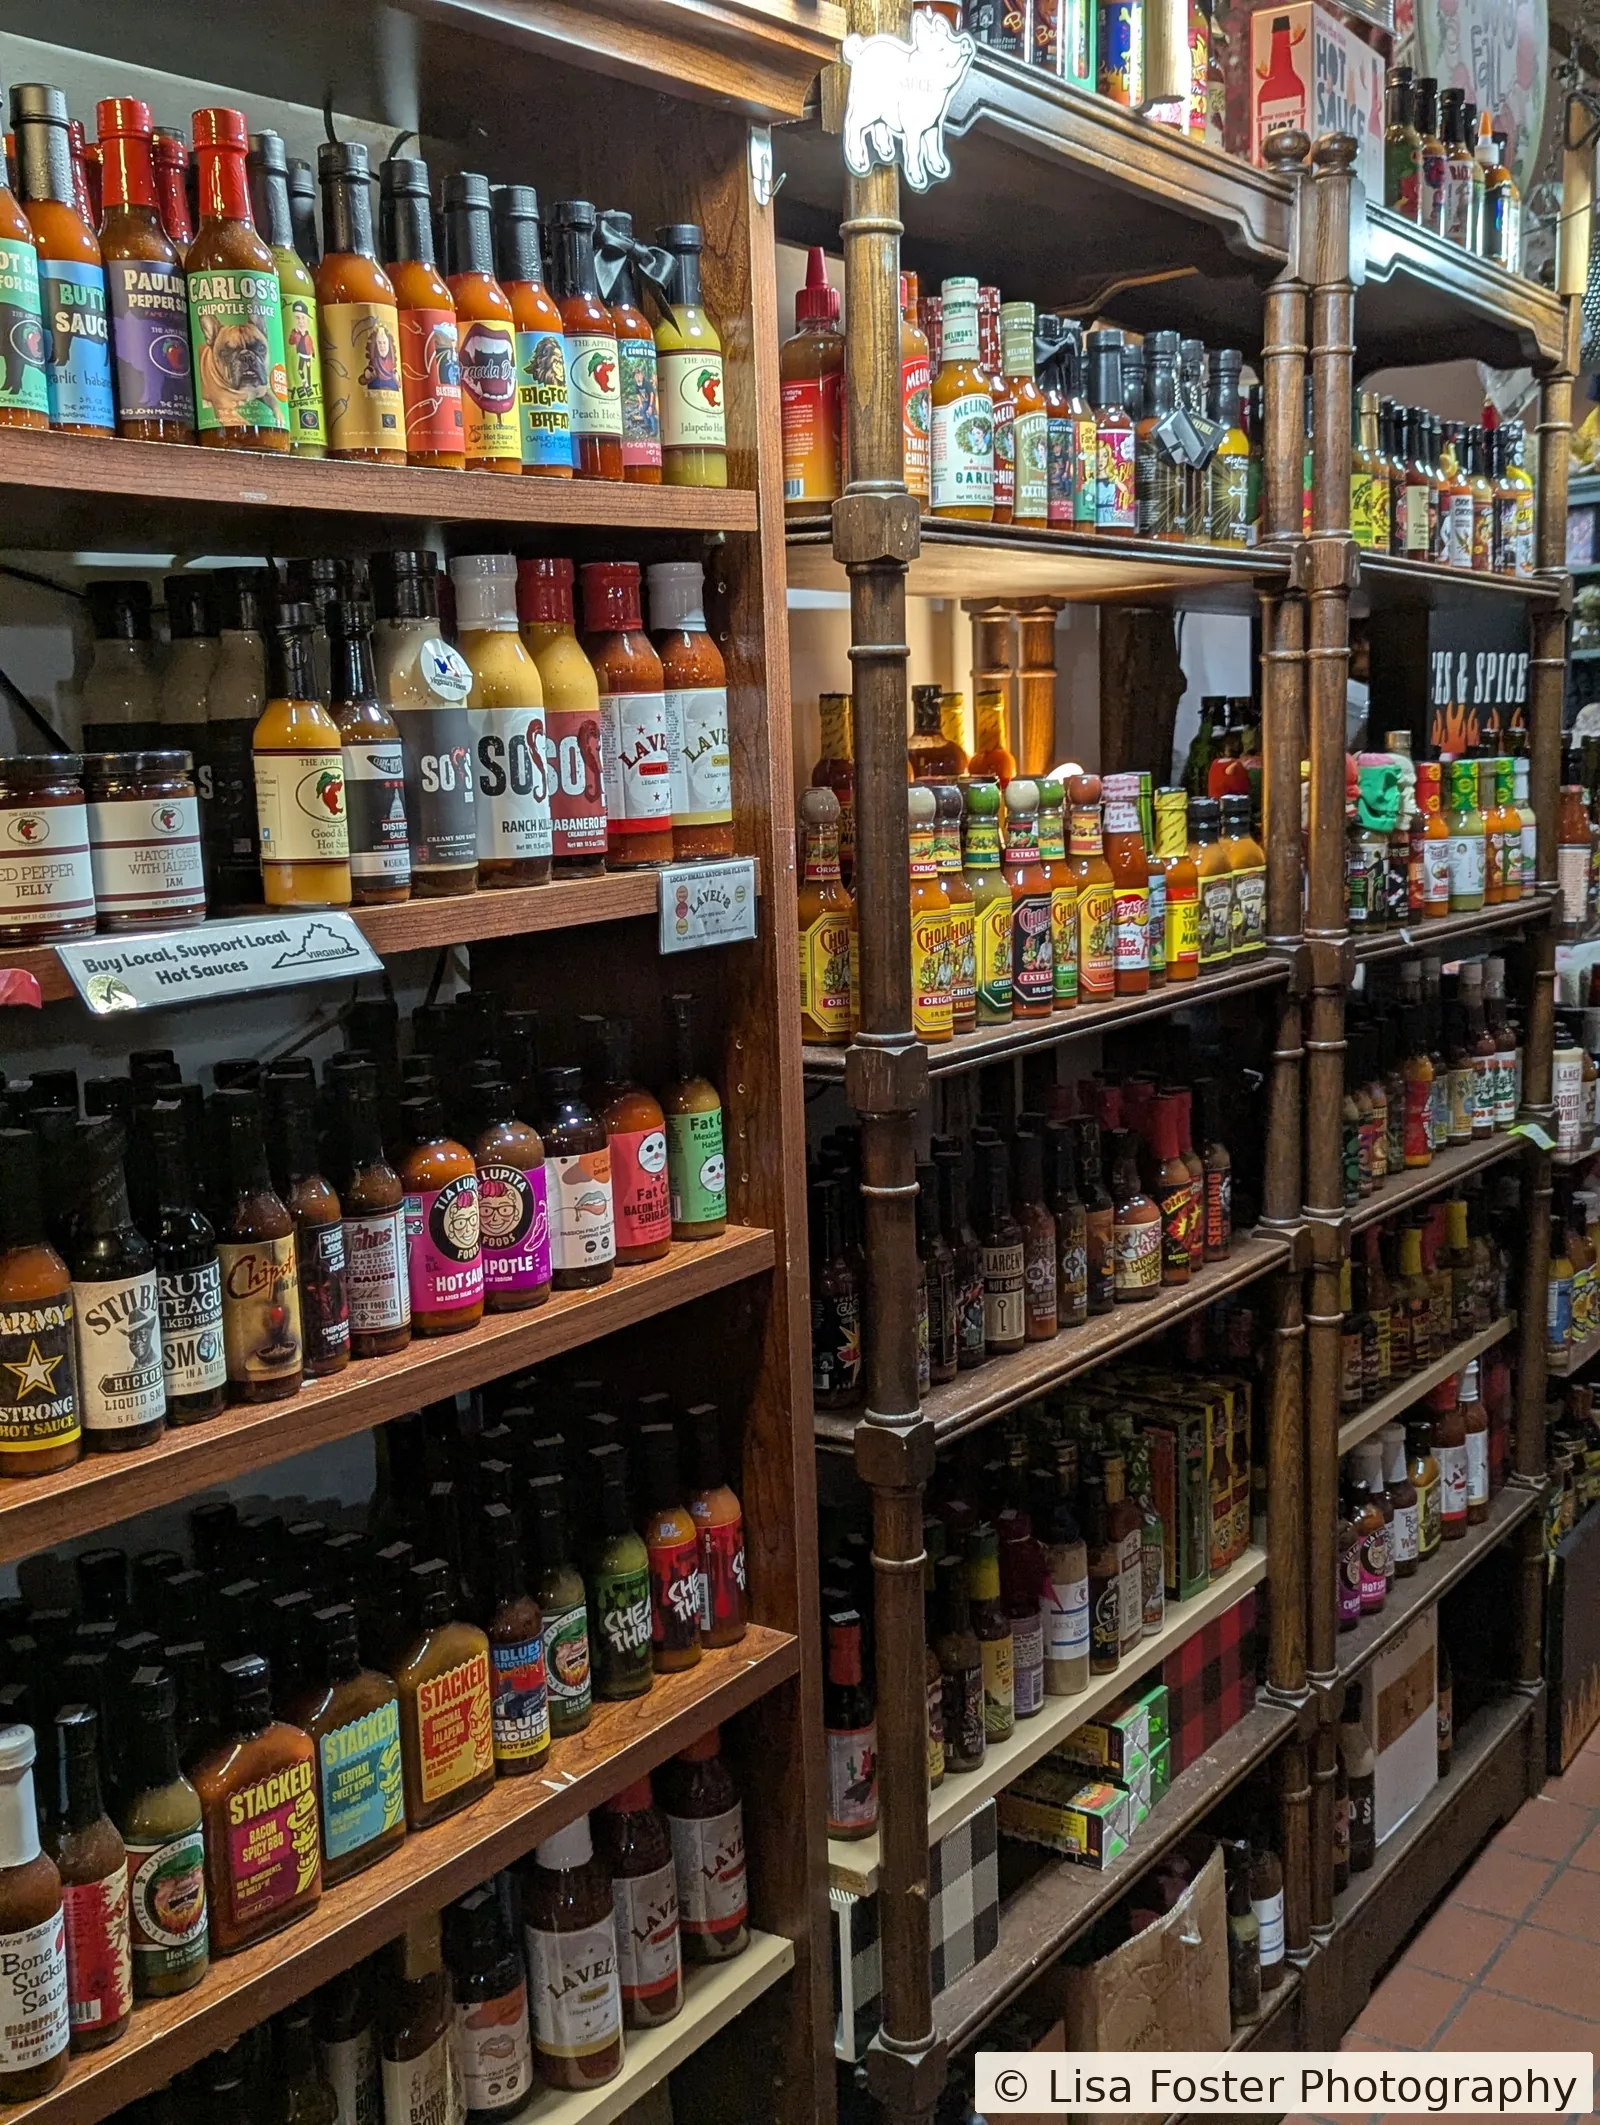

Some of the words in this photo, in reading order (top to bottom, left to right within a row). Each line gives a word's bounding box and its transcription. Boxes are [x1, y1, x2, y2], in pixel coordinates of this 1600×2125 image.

[1316, 34, 1346, 91] HOT
[1317, 83, 1365, 140] SAUCE
[0, 252, 20, 273] OT
[189, 276, 278, 303] CARLOS'S
[128, 294, 175, 309] PEPPER
[197, 303, 244, 316] CHIPOTLE
[247, 306, 275, 317] SAUCE
[574, 340, 590, 348] THE
[944, 330, 973, 341] MELINDA'S
[572, 409, 599, 419] Peach
[953, 399, 993, 422] MELIND
[681, 422, 712, 434] Jalapeño
[907, 438, 924, 451] THAI
[956, 471, 993, 484] GARLI
[1432, 651, 1453, 704] ES
[1457, 651, 1468, 703] &
[1474, 653, 1528, 704] SPICE
[618, 733, 667, 770] LAVE
[682, 728, 729, 763] LAVE
[299, 759, 318, 767] THE
[311, 829, 335, 839] Good
[337, 829, 344, 838] &
[502, 819, 537, 834] RANCH
[552, 817, 599, 834] ABANERO
[317, 839, 334, 849] Hot
[134, 849, 174, 862] HATCH
[1011, 851, 1034, 859] EXTRA
[0, 868, 18, 882] ED
[21, 863, 74, 880] PEPPER
[128, 864, 160, 875] WITH
[16, 883, 53, 898] JELLY
[166, 877, 183, 888] JAM
[689, 890, 731, 915] LAVEL'S
[1114, 898, 1138, 918] TEXAS
[1019, 907, 1051, 936] CHOL
[82, 958, 123, 974] Buy
[122, 948, 179, 969] Local,
[179, 936, 247, 960] Support
[248, 930, 291, 947] Local
[1117, 936, 1136, 948] Hot
[306, 947, 347, 960] VIRGINIA
[155, 969, 191, 985] Hot
[192, 960, 249, 979] Sauces
[1023, 973, 1050, 982] EXTRA
[1554, 1094, 1580, 1108] SORTA
[690, 1117, 714, 1132] Fat
[481, 1168, 527, 1192] LUPITA
[434, 1189, 455, 1211] TIA
[637, 1185, 659, 1201] Fat
[1207, 1173, 1222, 1246] SERRANO
[482, 1232, 516, 1247] FOODS
[227, 1247, 295, 1299] Chipot
[484, 1255, 534, 1275] IPOTLE
[156, 1265, 221, 1299] RUFU
[436, 1274, 465, 1292] HOT
[465, 1267, 484, 1287] SAU
[85, 1285, 157, 1336] STUBB
[158, 1290, 222, 1318] TEAGU
[0, 1304, 67, 1335] ARMY
[194, 1313, 210, 1324] HIS
[114, 1366, 163, 1391] HICKOR
[185, 1369, 196, 1380] IN
[197, 1367, 203, 1377] A
[0, 1395, 74, 1423] STRONG
[105, 1394, 148, 1411] LIQUID
[0, 1424, 30, 1438] HOT
[34, 1413, 75, 1433] SAUCE
[117, 1416, 124, 1424] 5
[125, 1413, 135, 1422] FL
[137, 1410, 147, 1420] OZ
[668, 1568, 699, 1603] CHE
[1362, 1582, 1377, 1593] HOT
[604, 1597, 651, 1634] CHEA
[499, 1642, 541, 1661] BLUES
[420, 1657, 486, 1713] STACKED
[495, 1707, 548, 1731] BLUES
[325, 1706, 397, 1766] STACKED
[495, 1721, 549, 1743] MOBILE
[500, 1740, 519, 1750] HOT
[520, 1734, 544, 1748] SAUCE
[337, 1760, 370, 1787] TERIYAKI
[229, 1760, 312, 1826] STACKED
[249, 1819, 278, 1841] BACON
[242, 1840, 268, 1864] SPICY
[267, 1831, 285, 1851] BBQ
[701, 1837, 746, 1881] LAVE
[631, 1895, 679, 1943] LAVE
[2, 1947, 53, 1977] Bone
[166, 1950, 182, 1961] Hot
[12, 1956, 66, 1997] Suckin
